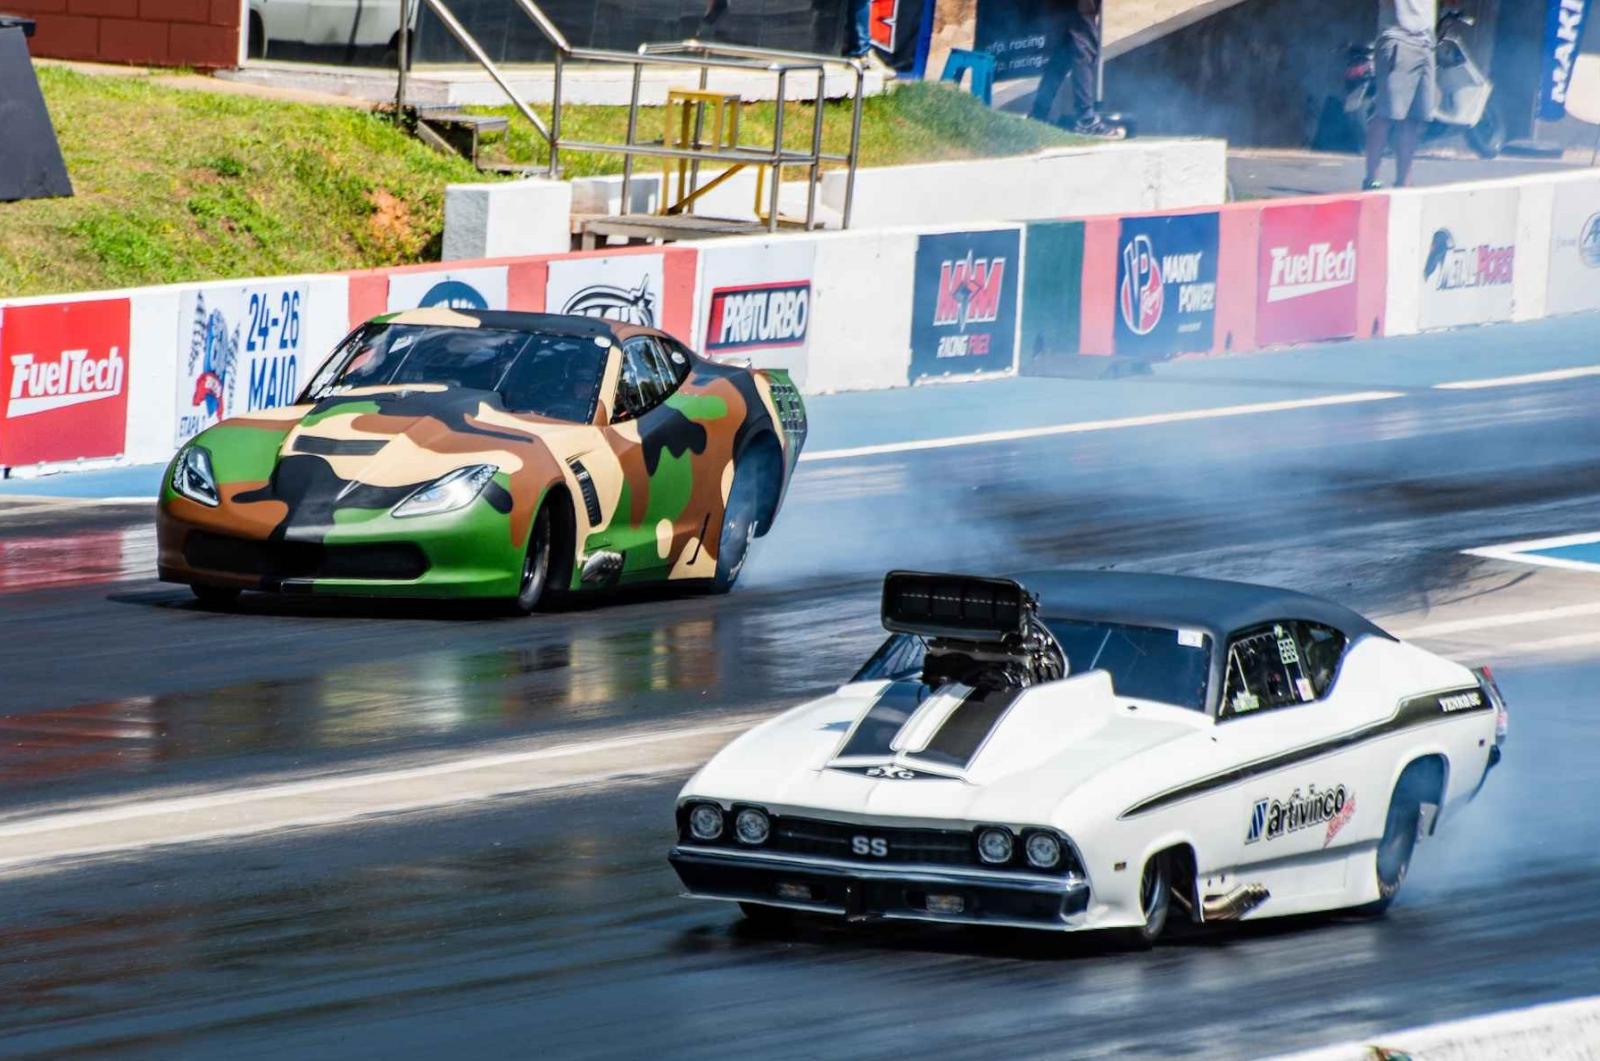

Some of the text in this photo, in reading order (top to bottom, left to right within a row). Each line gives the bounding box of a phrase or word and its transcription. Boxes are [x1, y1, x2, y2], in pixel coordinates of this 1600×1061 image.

[1269, 240, 1356, 287] FuelTech
[246, 289, 300, 352] 24-26
[719, 288, 808, 343] PROTURBO
[9, 346, 125, 400] FuelTech
[248, 354, 297, 412] MAIO
[852, 835, 888, 857] SS
